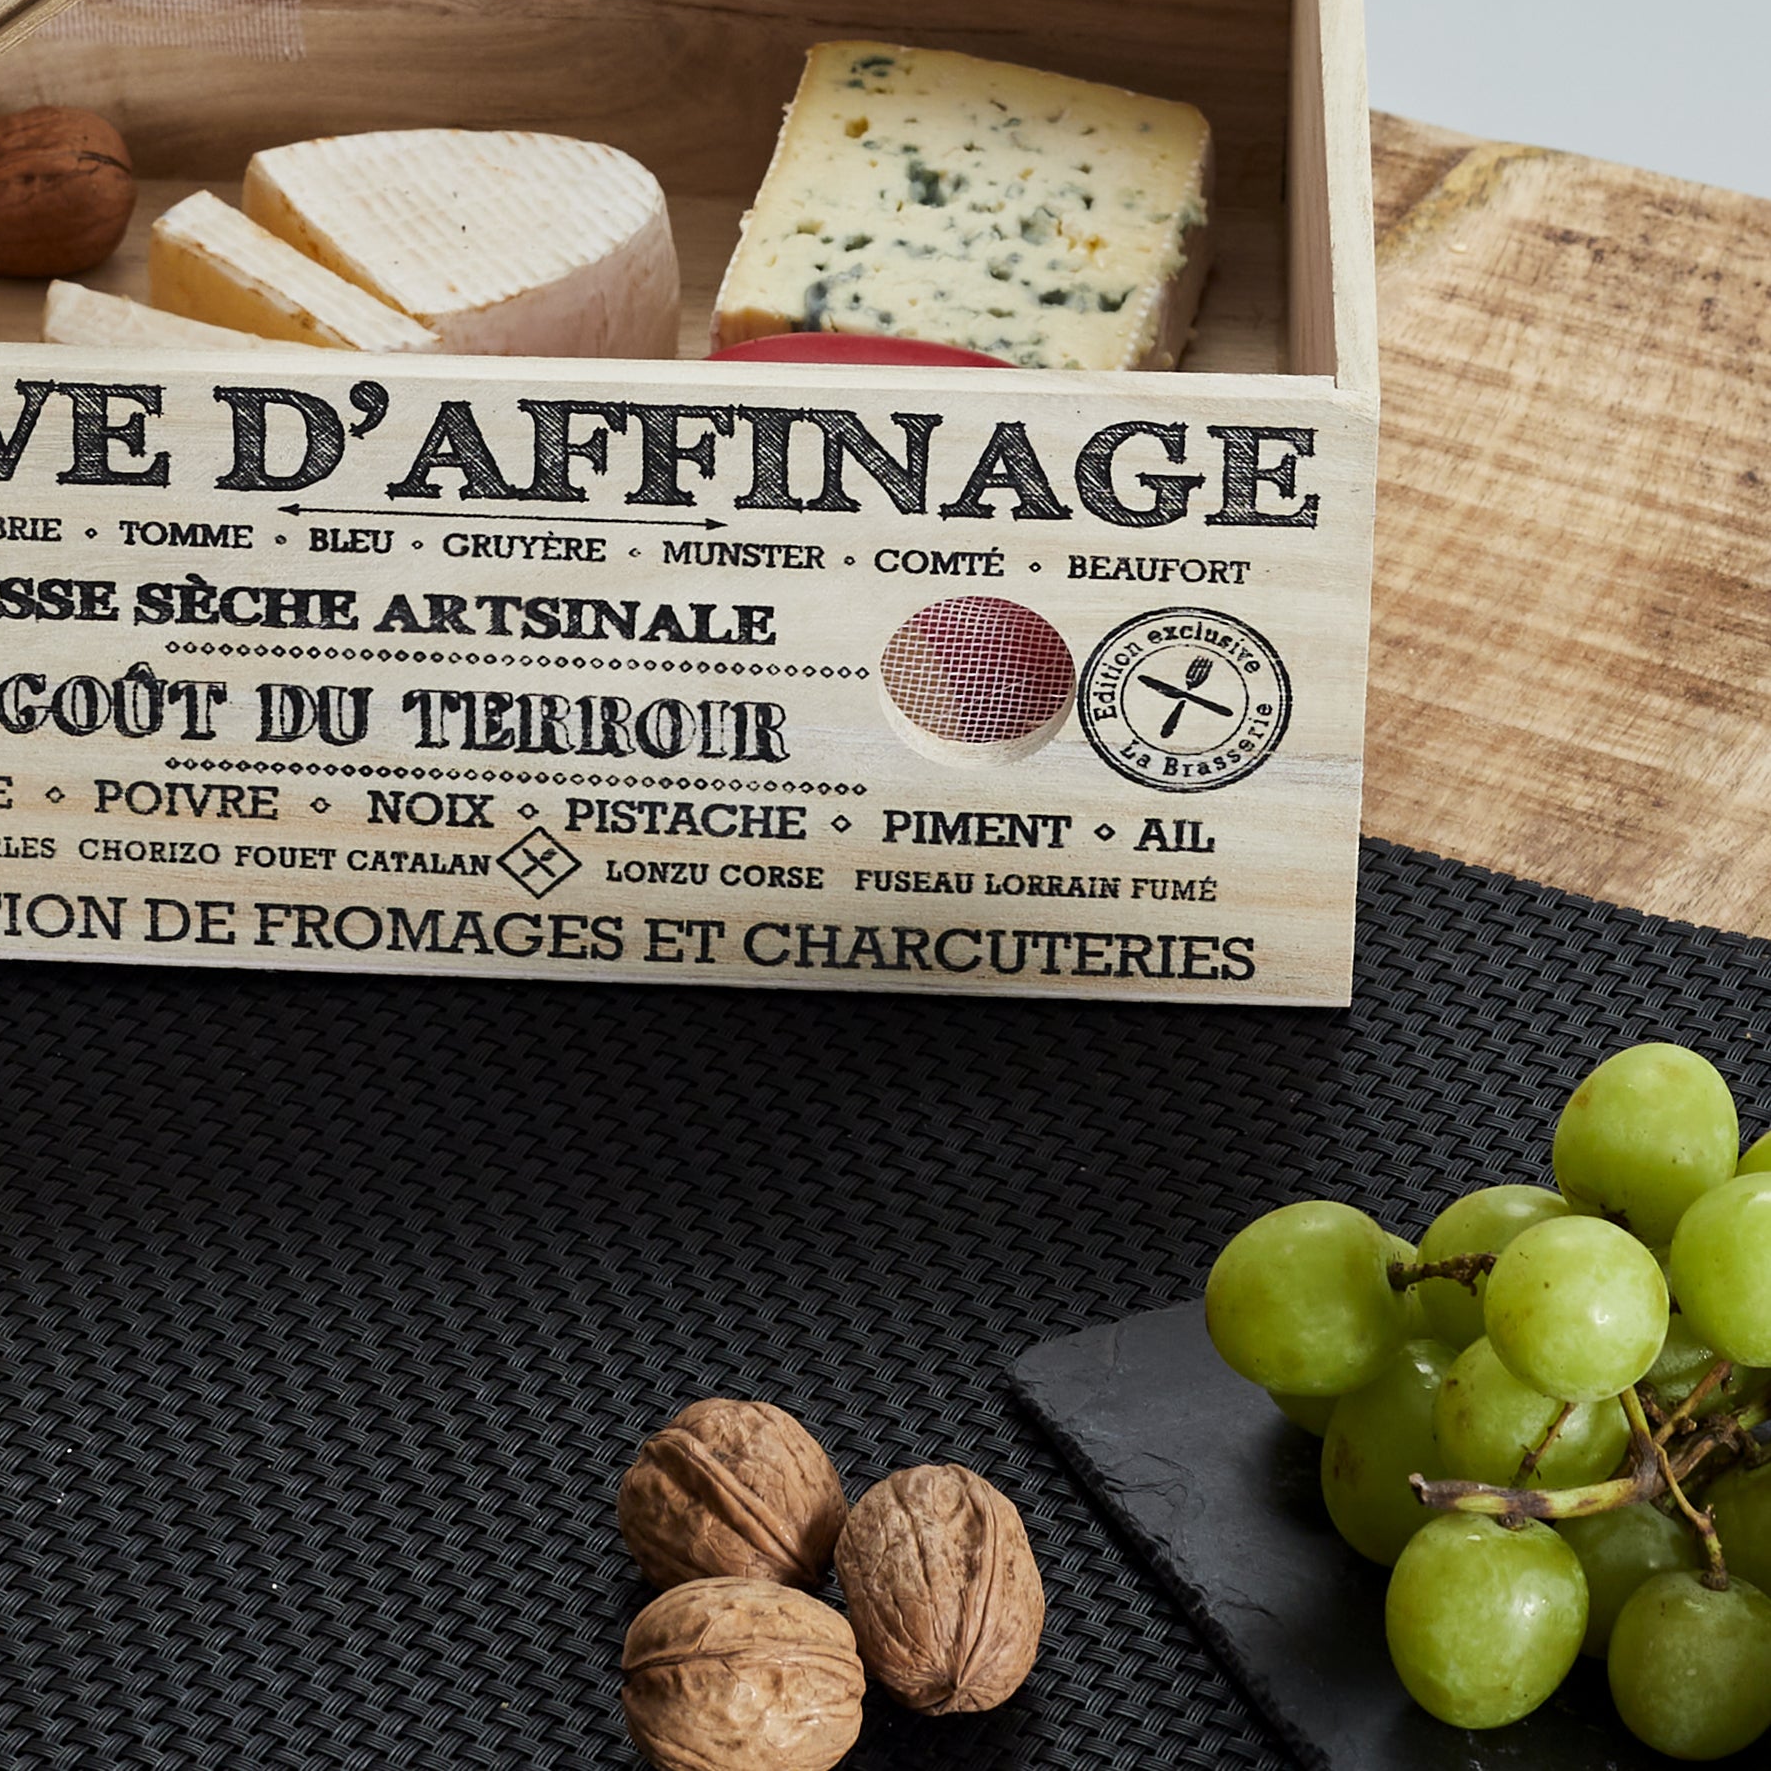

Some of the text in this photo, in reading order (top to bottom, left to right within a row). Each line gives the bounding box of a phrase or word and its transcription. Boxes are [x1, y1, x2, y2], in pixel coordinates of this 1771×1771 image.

[213, 380, 1320, 530] D’AFFINAGE
[118, 519, 254, 550] TOMME
[308, 526, 396, 555] BLEU
[442, 530, 607, 563] GRUYÈRE
[662, 540, 826, 570] MUNSTER
[873, 546, 1005, 578] COMTÉ
[1066, 554, 1252, 585] BEAUFORT
[133, 572, 360, 632] SÈCHE
[372, 592, 777, 646] ARTSINALE
[1093, 621, 1262, 722] Edition exclusive
[254, 682, 375, 747] DU
[401, 688, 791, 765] TERROIR
[1120, 702, 1274, 778] La Brasserie
[93, 778, 280, 821] POIVRE
[366, 789, 495, 829] NOIX
[564, 797, 807, 841] PISTACHE
[881, 809, 1073, 849] PIMENT
[1132, 817, 1216, 854] AIL
[78, 837, 490, 877] CHORIZO FOUET CATALAN
[605, 859, 825, 890] LONZU CORSE
[854, 869, 1218, 903] FUSEAU LORRAIN FUMÉ
[143, 897, 237, 946] DE
[253, 902, 625, 964] FROMAGES
[643, 917, 726, 965] ET
[742, 921, 1256, 982] CHARCUTERIES
